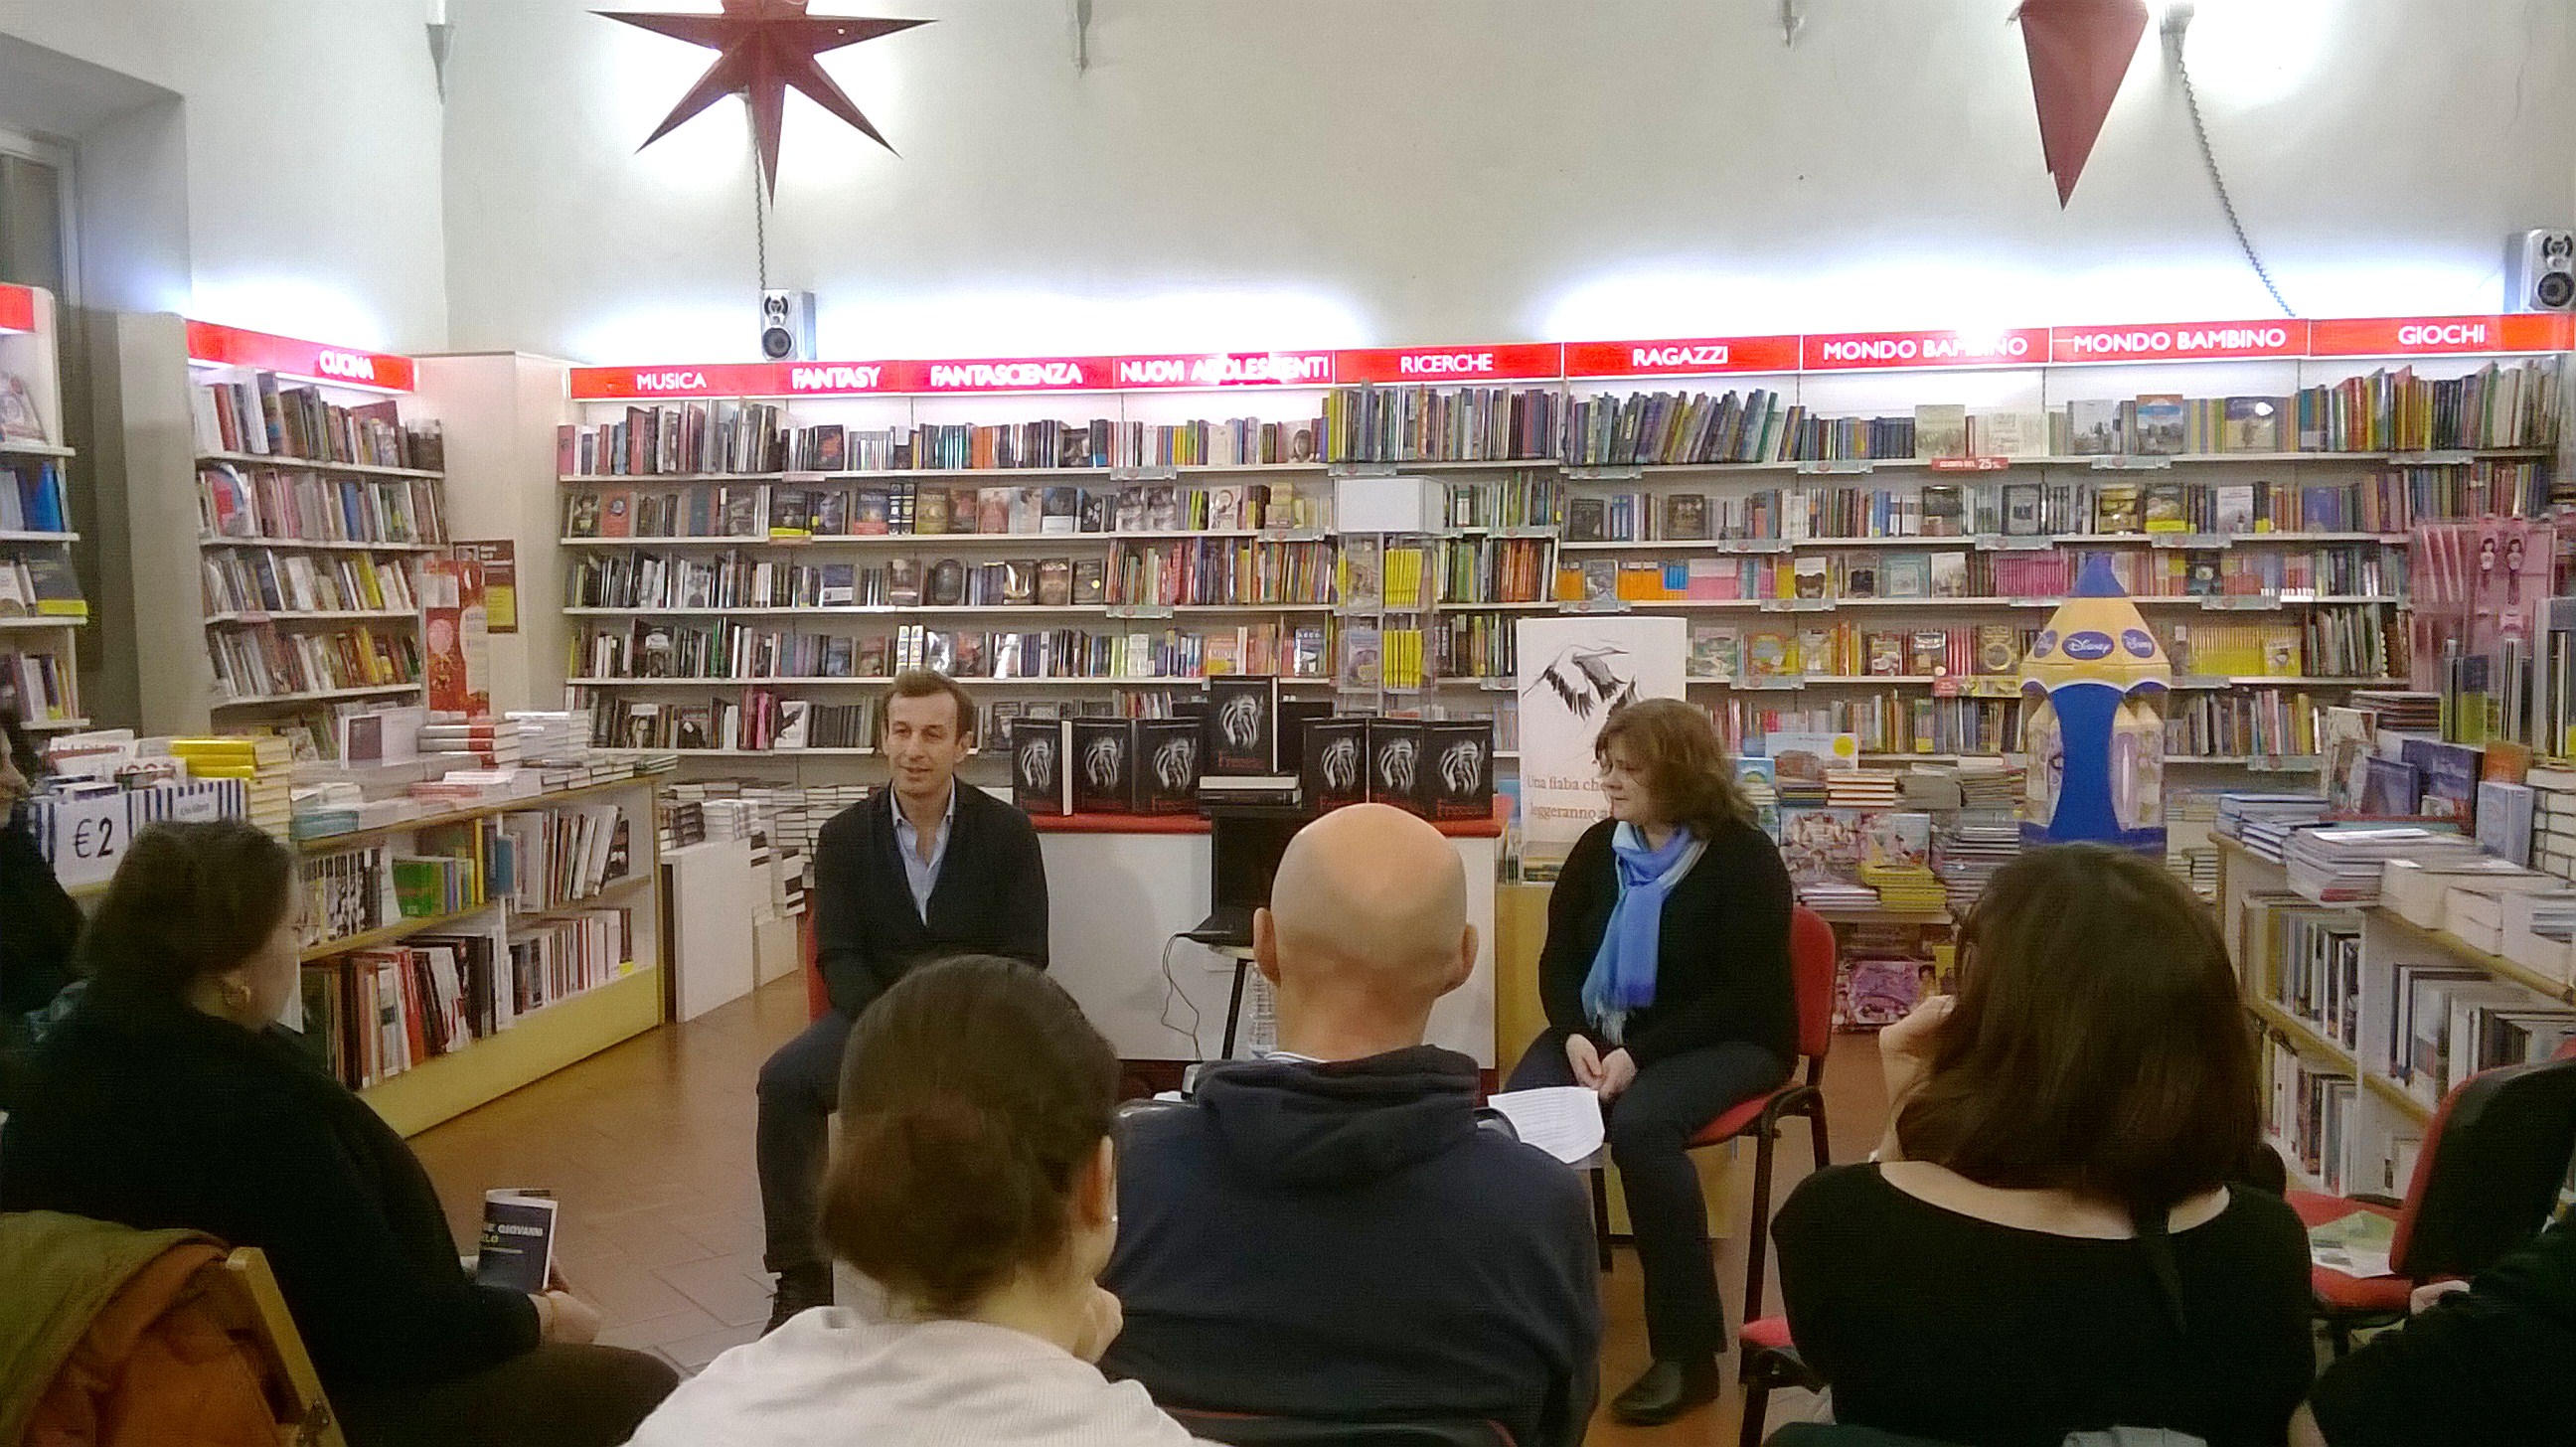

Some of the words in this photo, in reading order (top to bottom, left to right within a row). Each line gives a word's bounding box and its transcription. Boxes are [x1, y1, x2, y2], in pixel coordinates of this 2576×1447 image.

[2074, 331, 2171, 353] MONDO
[2176, 328, 2286, 351] BAMBINO
[2398, 324, 2485, 345] GIOCHI
[1633, 346, 1728, 367] RAGAZZI
[1824, 339, 1917, 361] MONDO
[1922, 336, 2028, 359] BAMNO
[1120, 359, 1185, 383] NUOVI
[1191, 356, 1328, 382] AOLESENTI
[1400, 354, 1493, 374] RICERCHE
[636, 372, 707, 391] MUSICA
[791, 366, 882, 389] FANTASY
[1549, 777, 1579, 790] fiaba
[1583, 777, 1603, 791] ch
[498, 1223, 544, 1237] GIOVANNI
